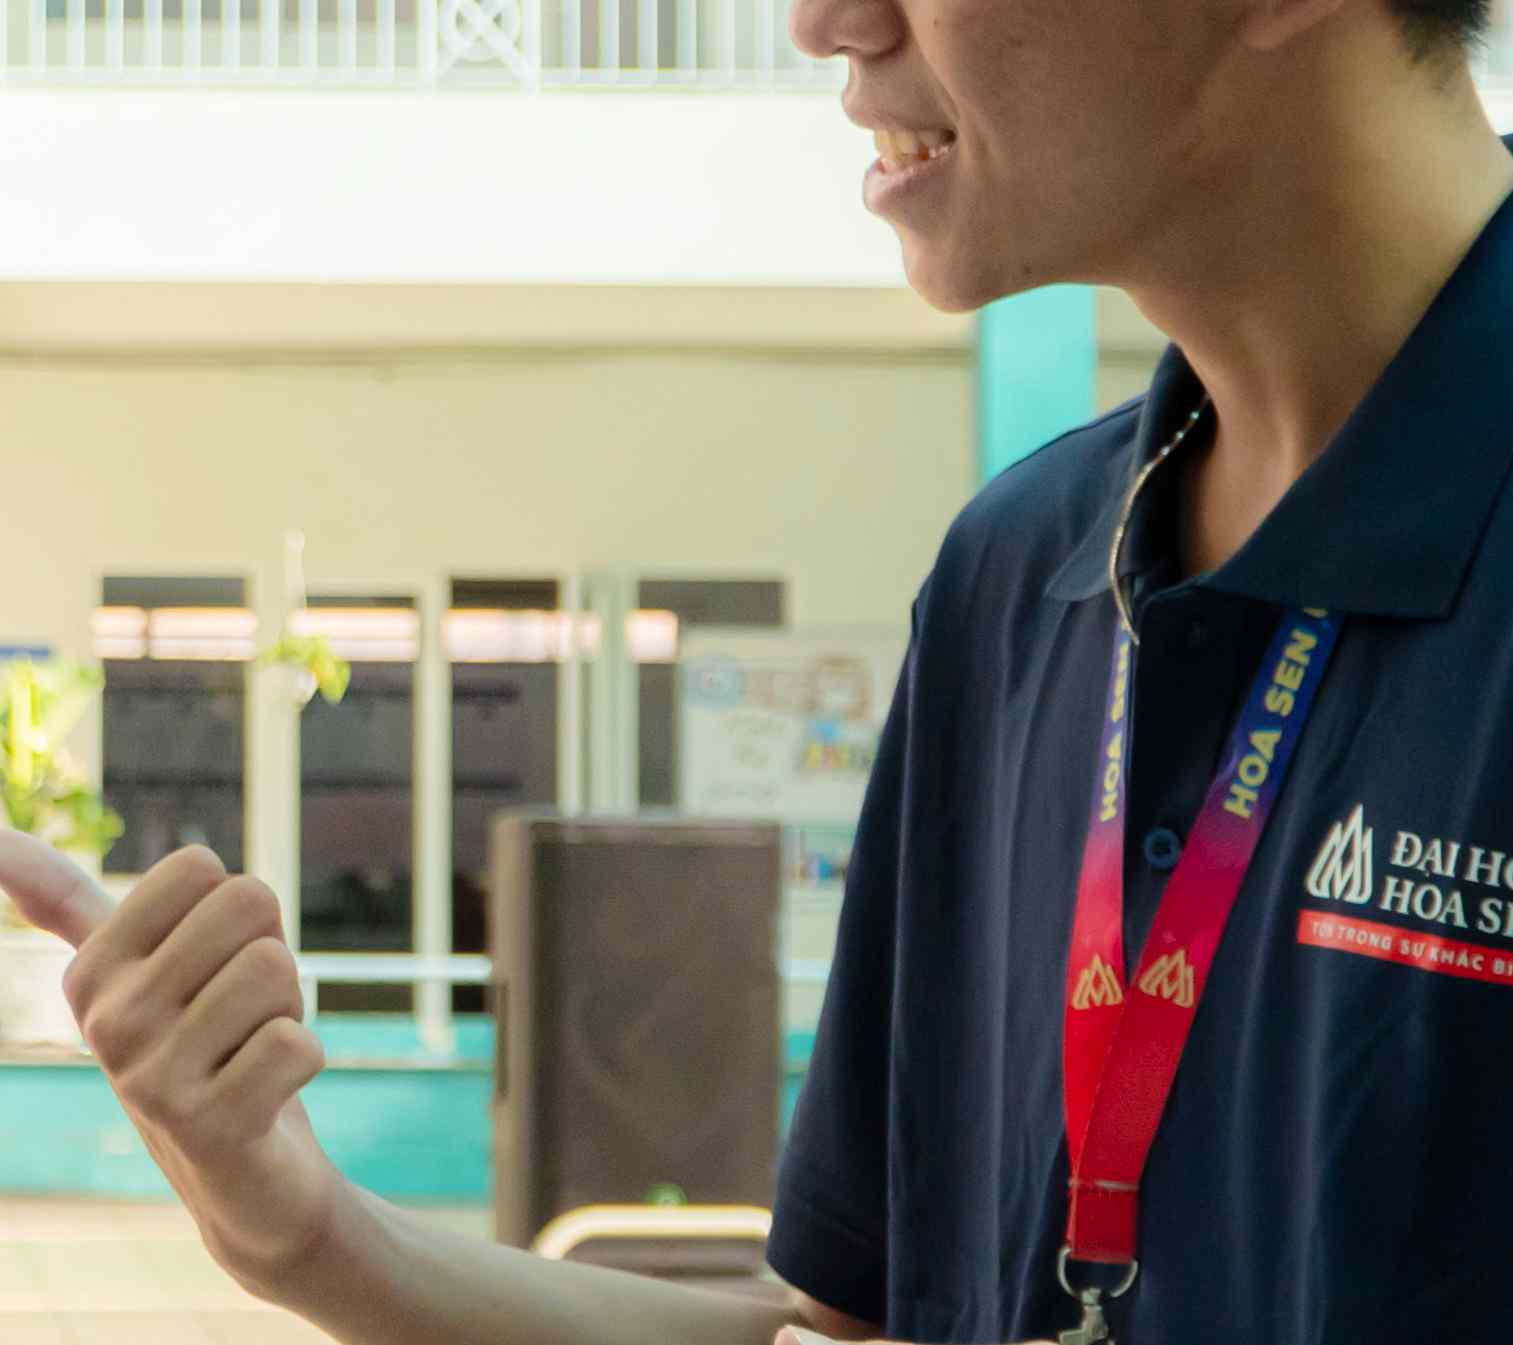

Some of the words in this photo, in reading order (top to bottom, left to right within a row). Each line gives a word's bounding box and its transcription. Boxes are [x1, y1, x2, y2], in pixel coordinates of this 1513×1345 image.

[1224, 730, 1281, 820] HOA
[1265, 629, 1317, 717] SEN
[1391, 831, 1461, 877] ĐẠI
[1380, 876, 1468, 928] HOA
